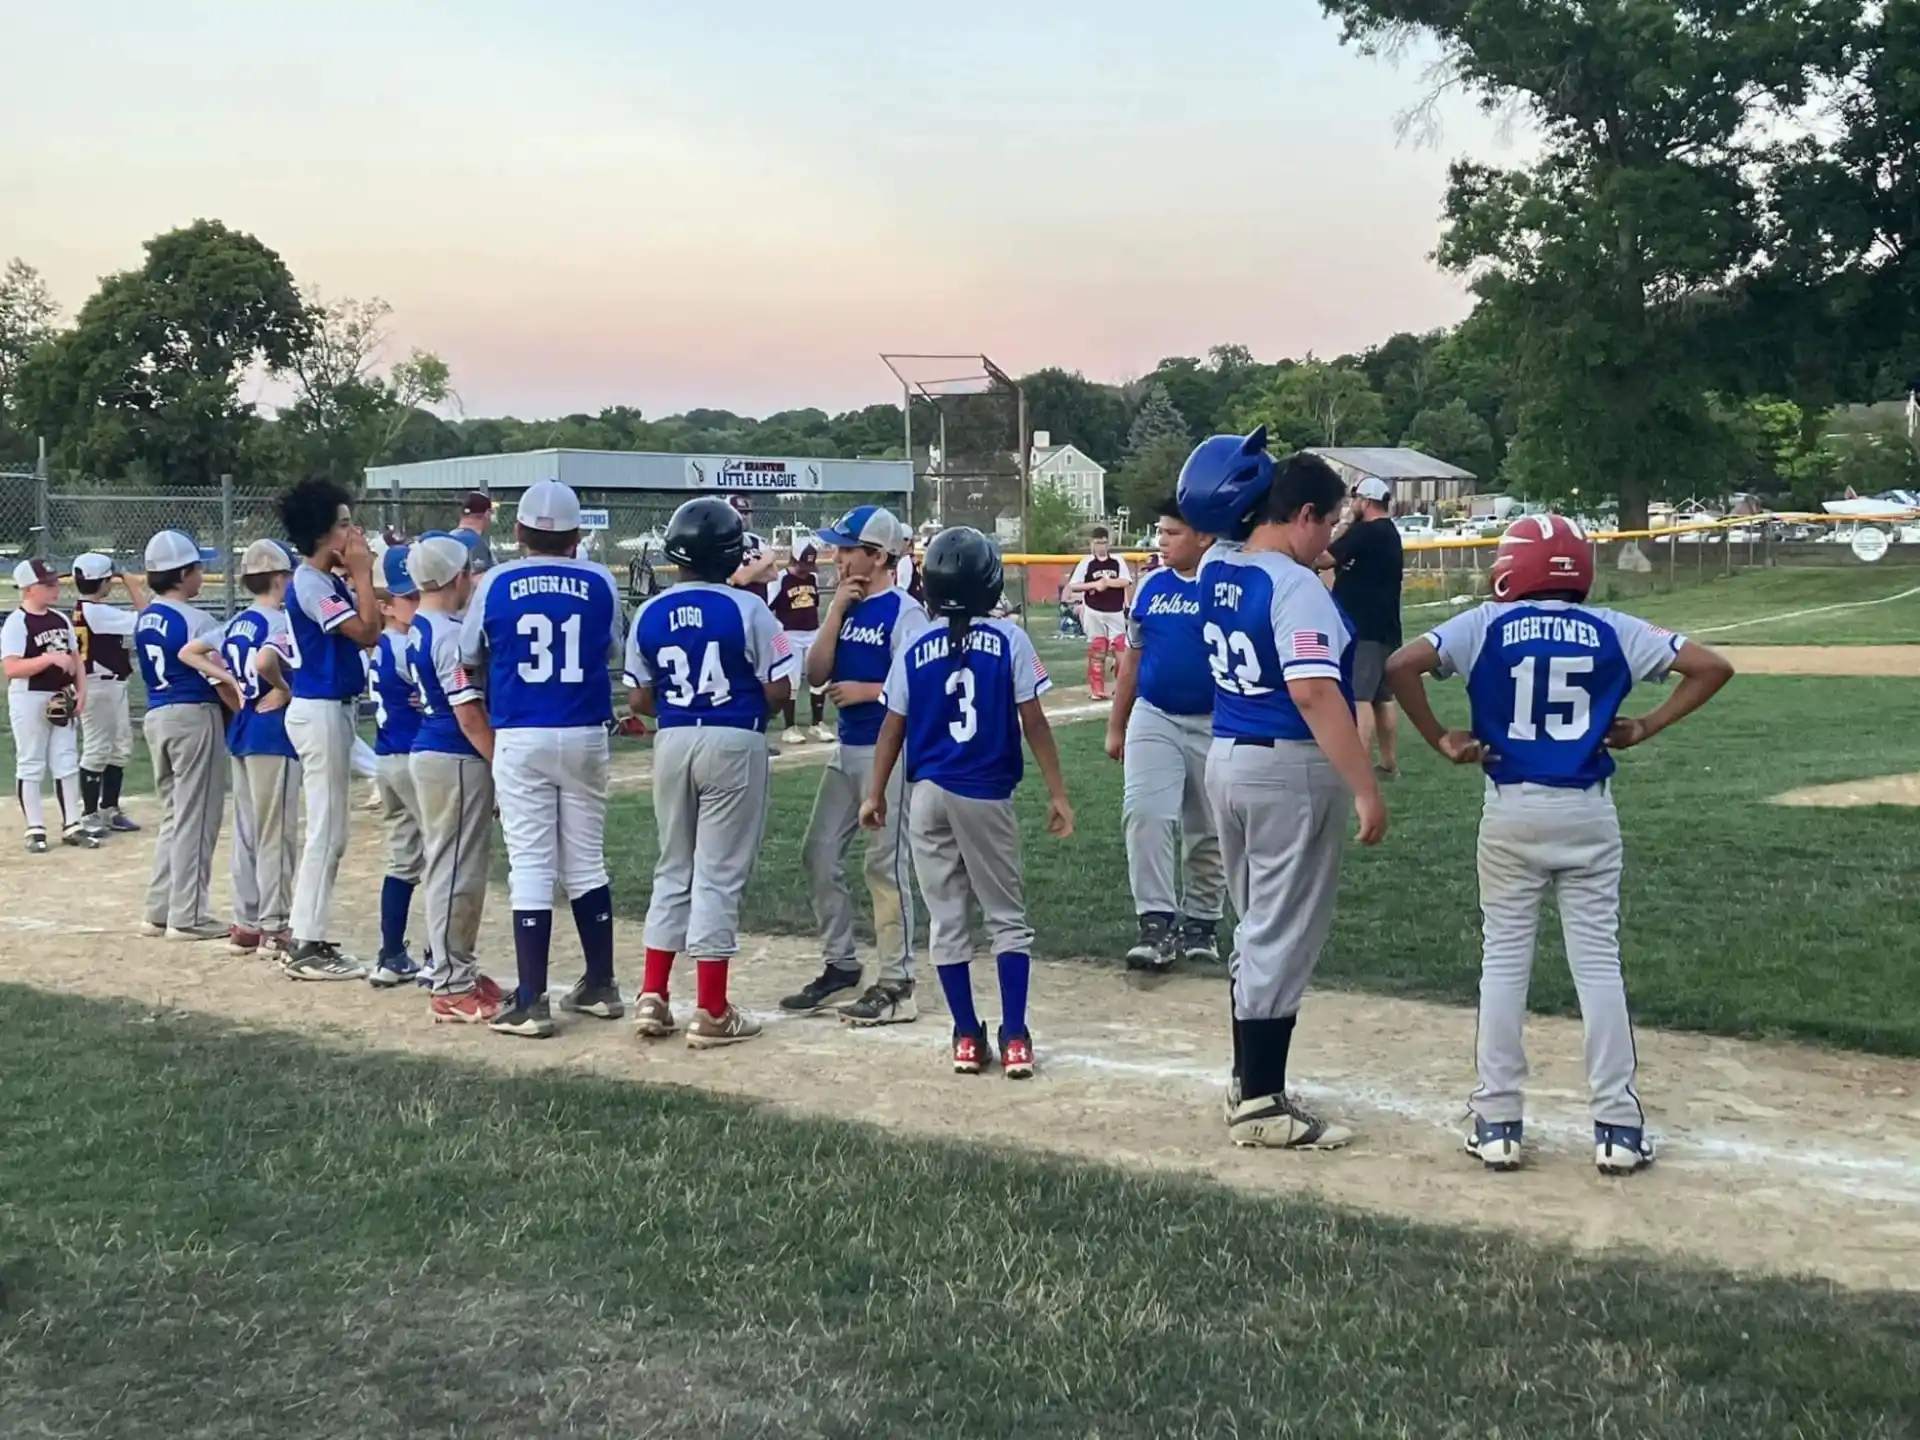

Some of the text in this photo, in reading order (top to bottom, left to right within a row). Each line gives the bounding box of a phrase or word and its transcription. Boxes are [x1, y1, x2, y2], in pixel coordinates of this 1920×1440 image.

[717, 472, 797, 487] LITTLE LEAGUE
[669, 606, 704, 632] LUGO
[1146, 592, 1200, 616] Holbro
[1502, 616, 1600, 648] HIGHTOWER
[144, 644, 169, 690] 7
[516, 613, 584, 683] 31
[656, 641, 733, 708] 34
[1203, 621, 1275, 697] 22
[945, 667, 977, 744] 3
[1507, 656, 1594, 741] 15
